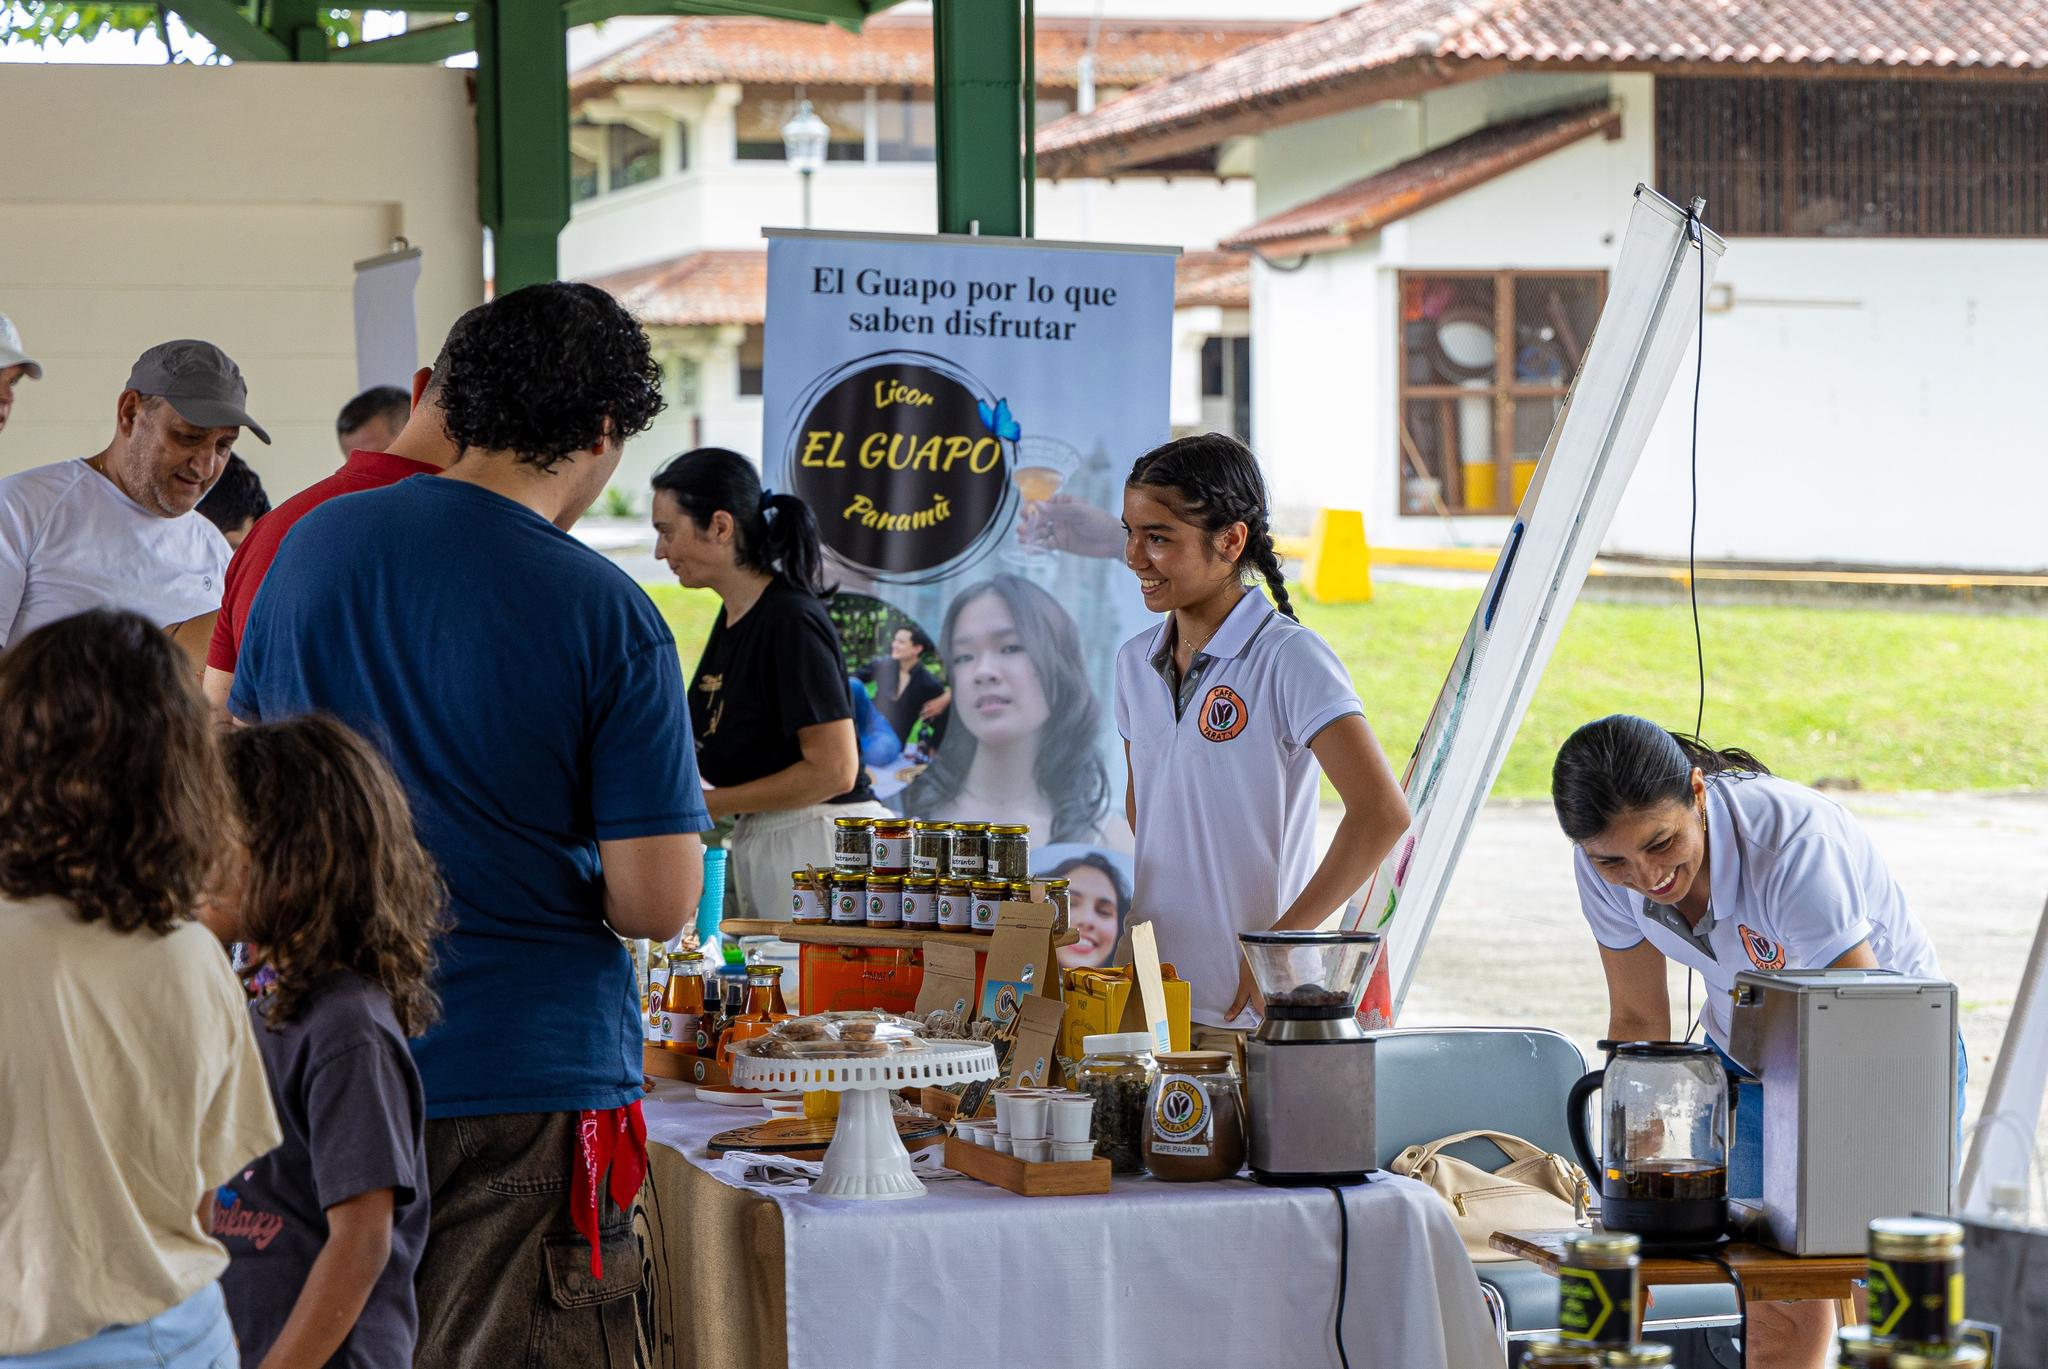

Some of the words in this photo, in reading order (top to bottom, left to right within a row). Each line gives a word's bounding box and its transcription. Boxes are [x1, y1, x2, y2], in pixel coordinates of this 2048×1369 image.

[813, 266, 844, 294] El
[856, 269, 957, 305] Guapo
[967, 281, 1017, 307] por
[1028, 276, 1055, 303] lo
[1064, 286, 1117, 312] que
[849, 307, 935, 334] saben
[945, 310, 1077, 341] disfrutar
[874, 379, 934, 408] Licor
[801, 430, 847, 469] EL
[858, 432, 1001, 474] GUAPO
[1213, 689, 1233, 700] CAFE
[1203, 726, 1233, 740] PARATY
[1154, 1144, 1172, 1153] CAFE
[1172, 1145, 1201, 1154] PARATY
